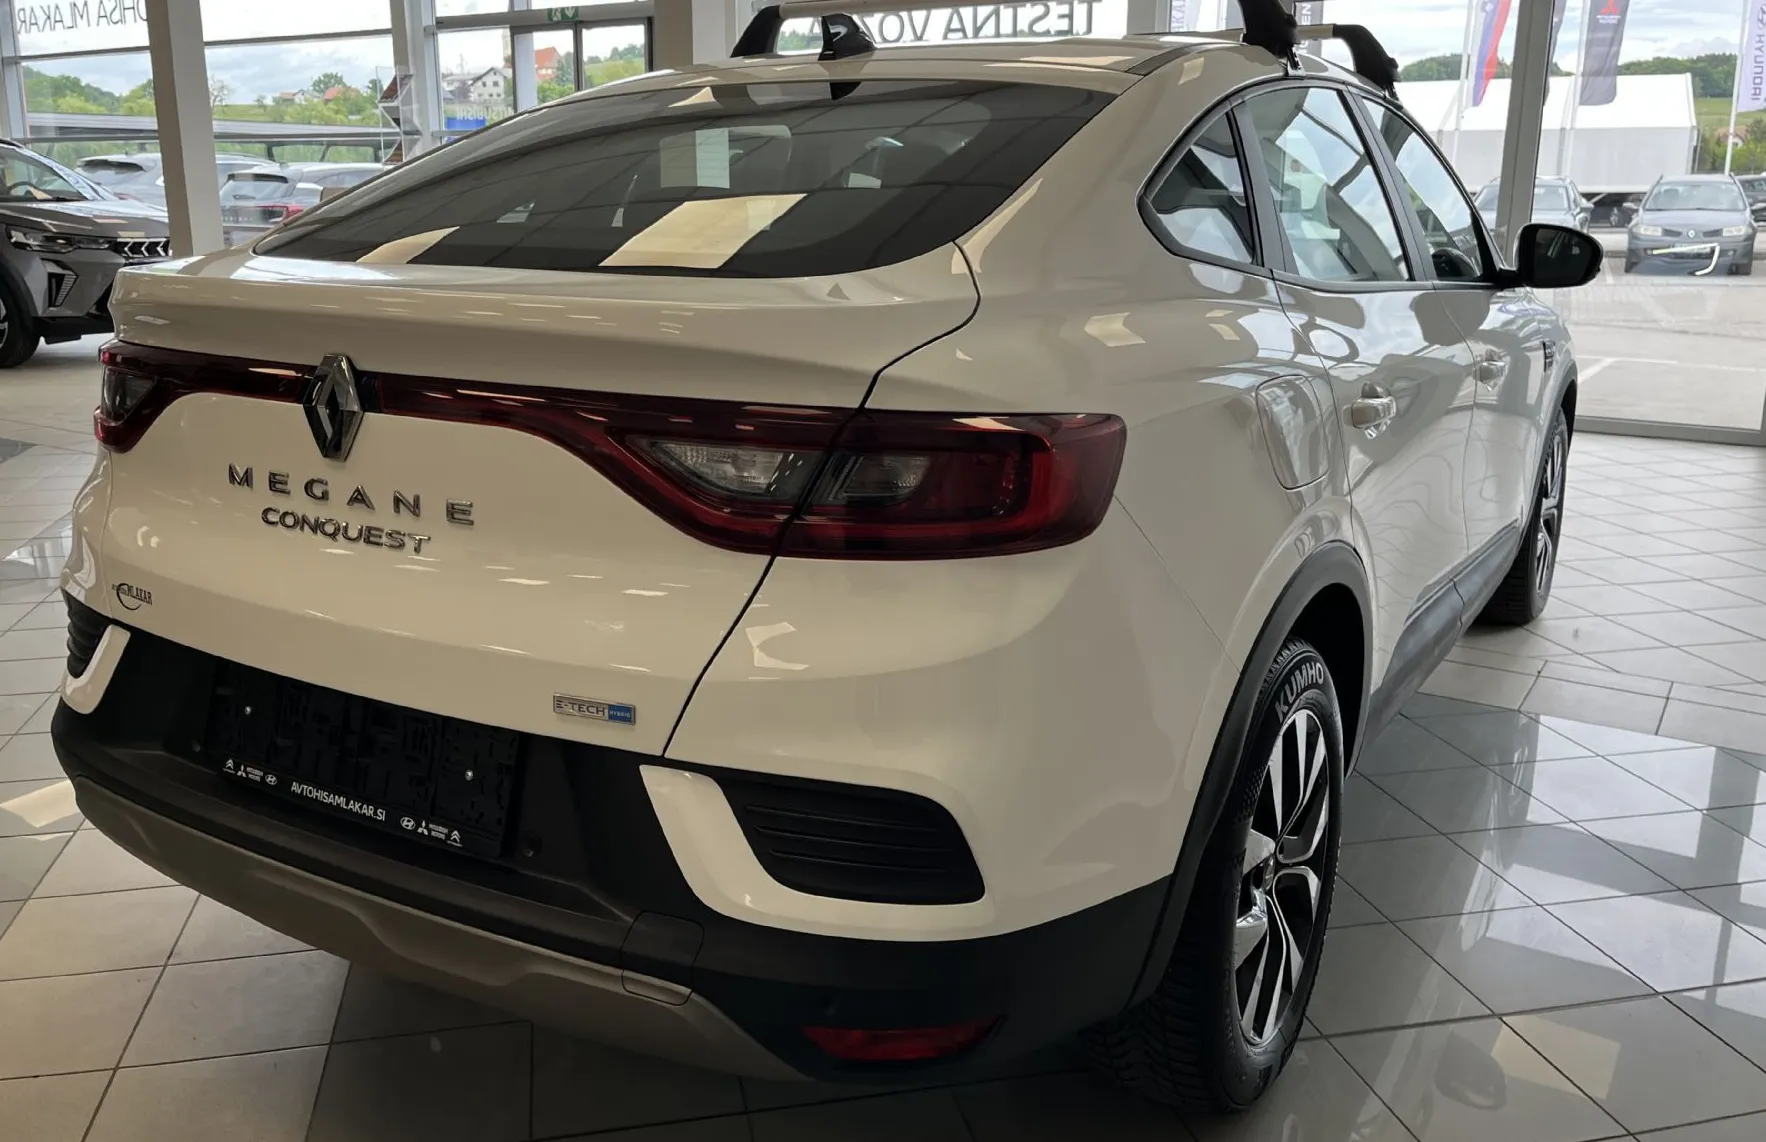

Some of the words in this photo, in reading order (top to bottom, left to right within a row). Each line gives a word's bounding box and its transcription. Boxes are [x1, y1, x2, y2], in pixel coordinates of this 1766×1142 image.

[1751, 34, 1765, 101] HYUNDAI
[228, 463, 475, 526] MEGANE
[261, 506, 431, 554] CONQUEST
[556, 699, 605, 716] E-TECH
[1275, 661, 1324, 723] KUMHO
[290, 781, 386, 822] AVTOHISAMLAKAR.SI
